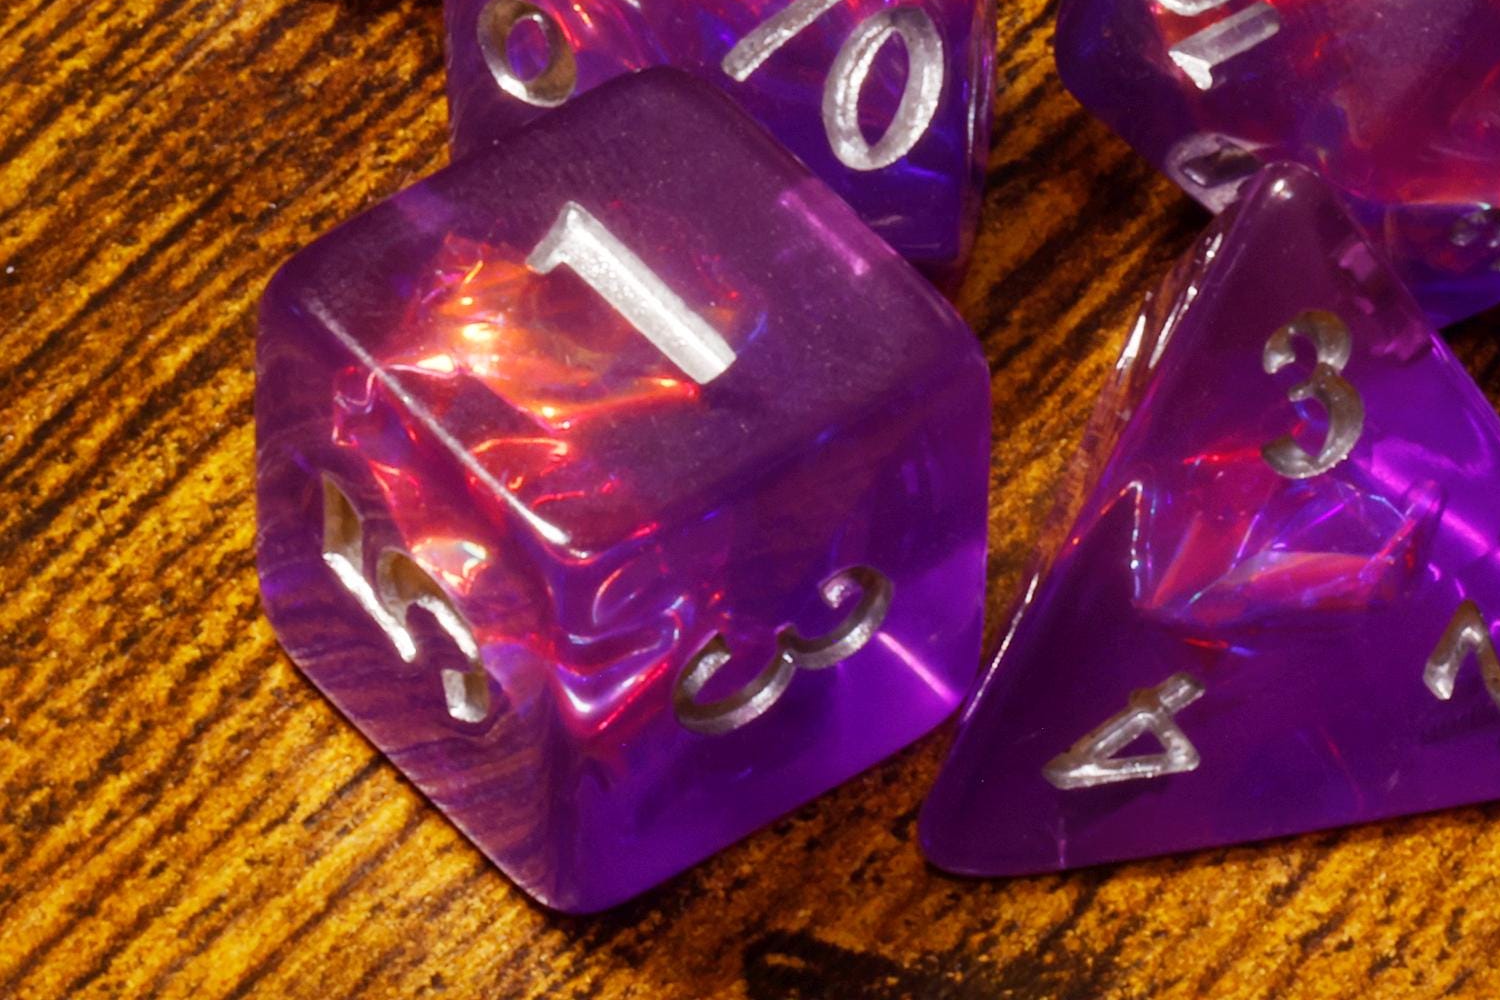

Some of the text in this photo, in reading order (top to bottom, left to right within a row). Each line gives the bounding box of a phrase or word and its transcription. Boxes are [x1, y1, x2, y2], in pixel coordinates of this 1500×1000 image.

[525, 200, 738, 385] 1
[1260, 309, 1364, 480] 3
[673, 564, 895, 736] 3
[1041, 671, 1206, 791] 4
